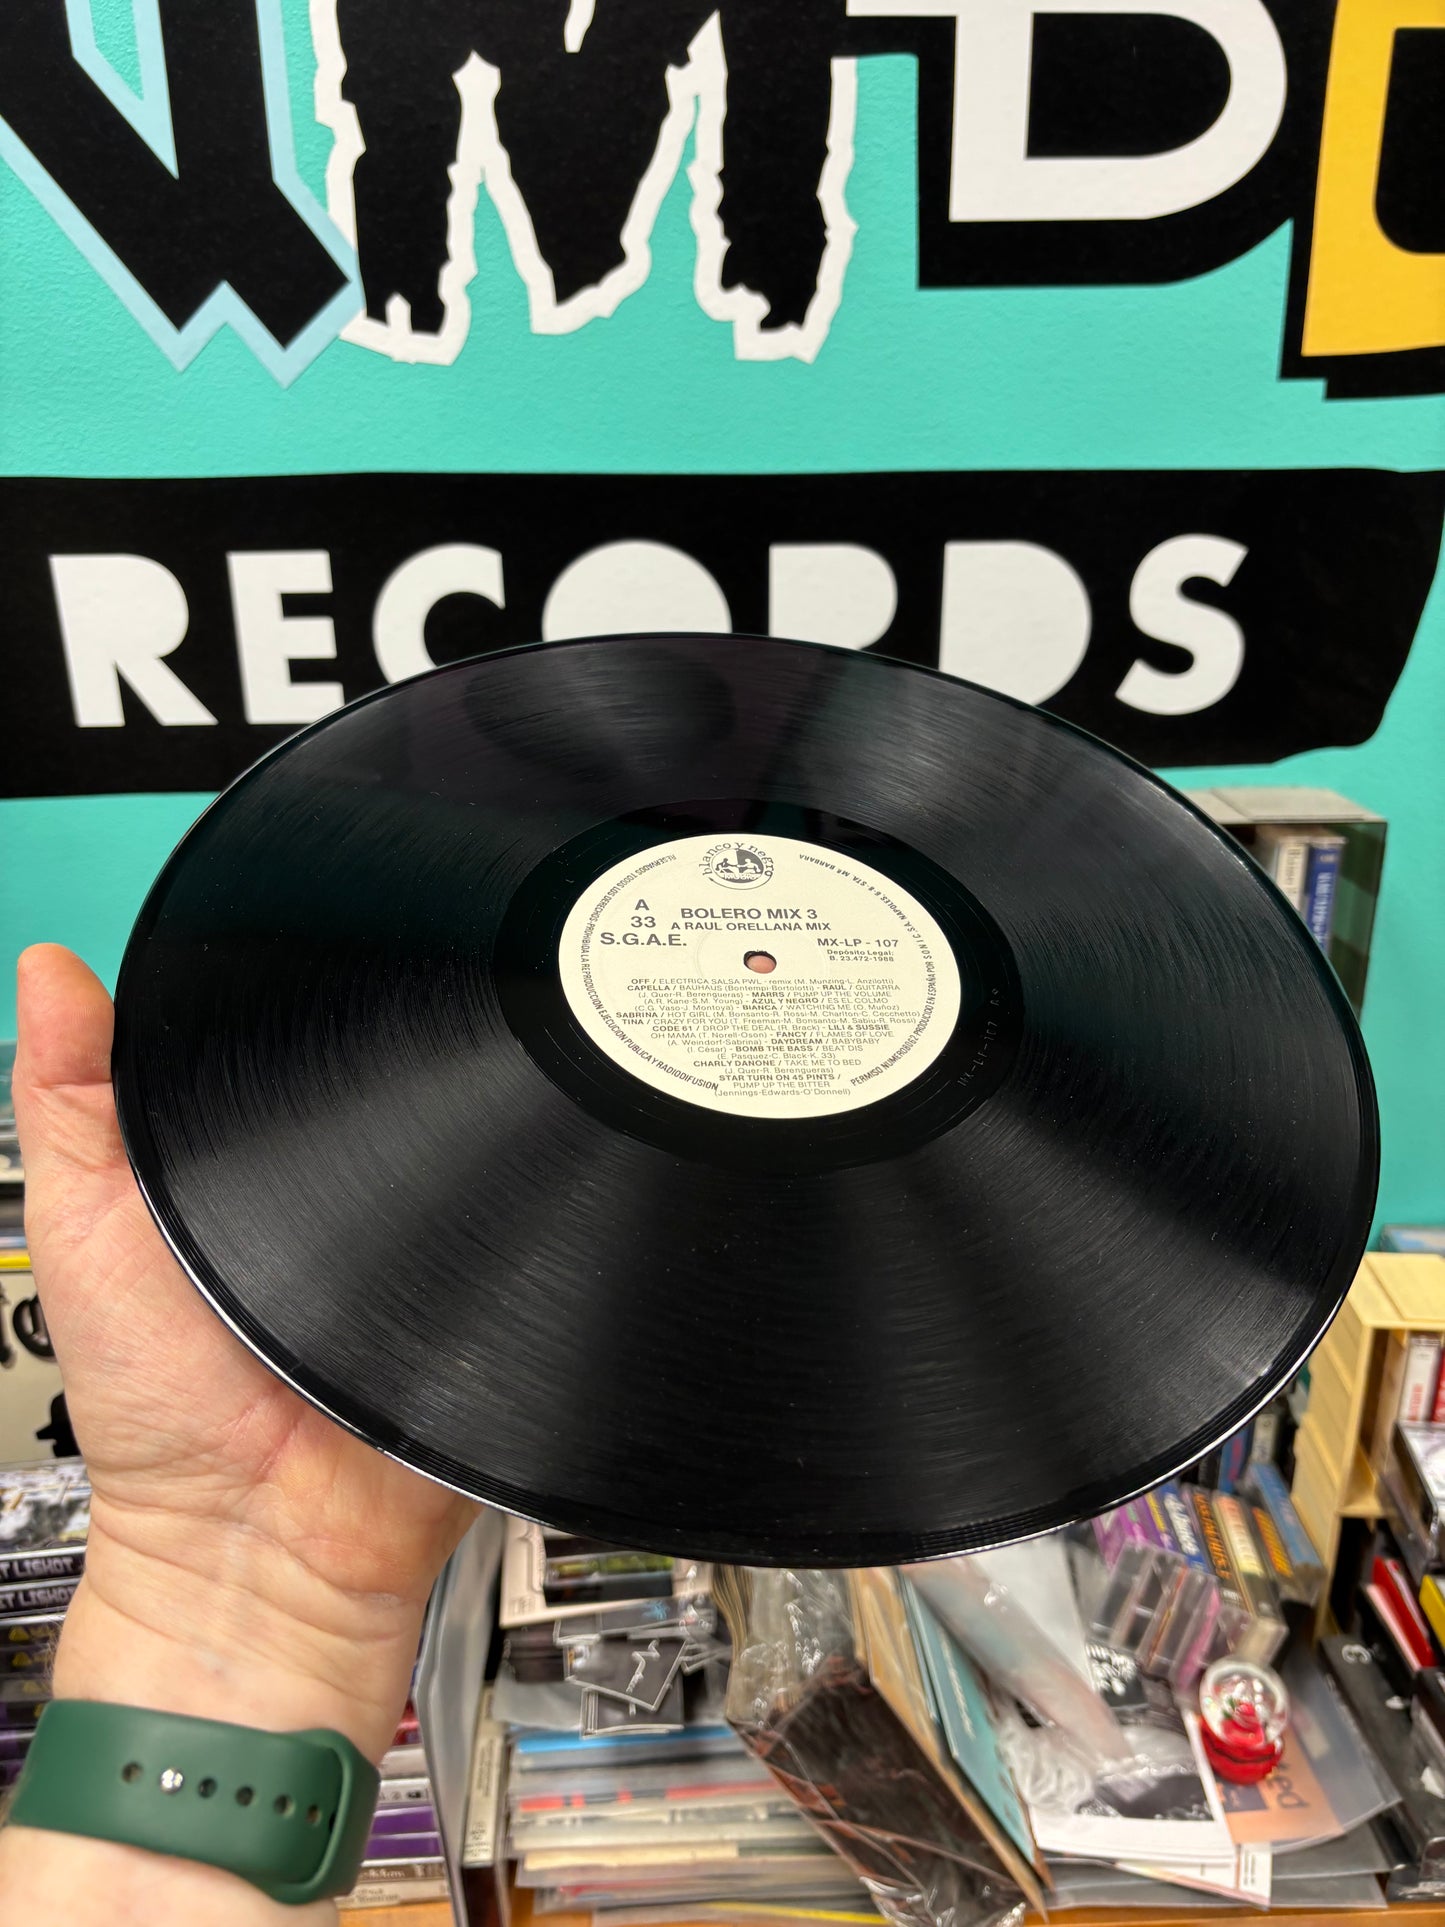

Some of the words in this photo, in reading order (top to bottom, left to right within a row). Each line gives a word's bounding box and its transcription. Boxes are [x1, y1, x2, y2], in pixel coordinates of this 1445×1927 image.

[699, 842, 731, 876] blanco
[734, 842, 745, 852] y
[748, 845, 774, 877] negro
[617, 872, 638, 889] TODOS
[607, 886, 622, 896] LOS
[635, 899, 649, 911] A
[681, 908, 762, 919] BOLERO
[767, 908, 802, 919] MIX
[807, 909, 818, 919] 3
[631, 916, 656, 928] 33
[671, 922, 681, 930] A
[684, 922, 722, 931] RAUL
[726, 922, 801, 931] ORELLANA
[806, 923, 832, 931] MIX
[600, 932, 687, 946] S.G.A.E.
[817, 938, 862, 947] MX-LP
[875, 939, 899, 947] 107
[580, 954, 589, 963] LA
[867, 949, 894, 957] Legal:
[925, 961, 936, 973] POR
[581, 963, 604, 1010] REPRODUCCION
[927, 973, 937, 996] ESPAÑA
[926, 996, 935, 1005] EN
[598, 1009, 628, 1041] EJECUCION
[667, 1038, 678, 1046] (A.
[623, 1038, 652, 1061] PUBLICA
[656, 1061, 719, 1091] RADIODIFUSION
[850, 1066, 884, 1087] PERMISO
